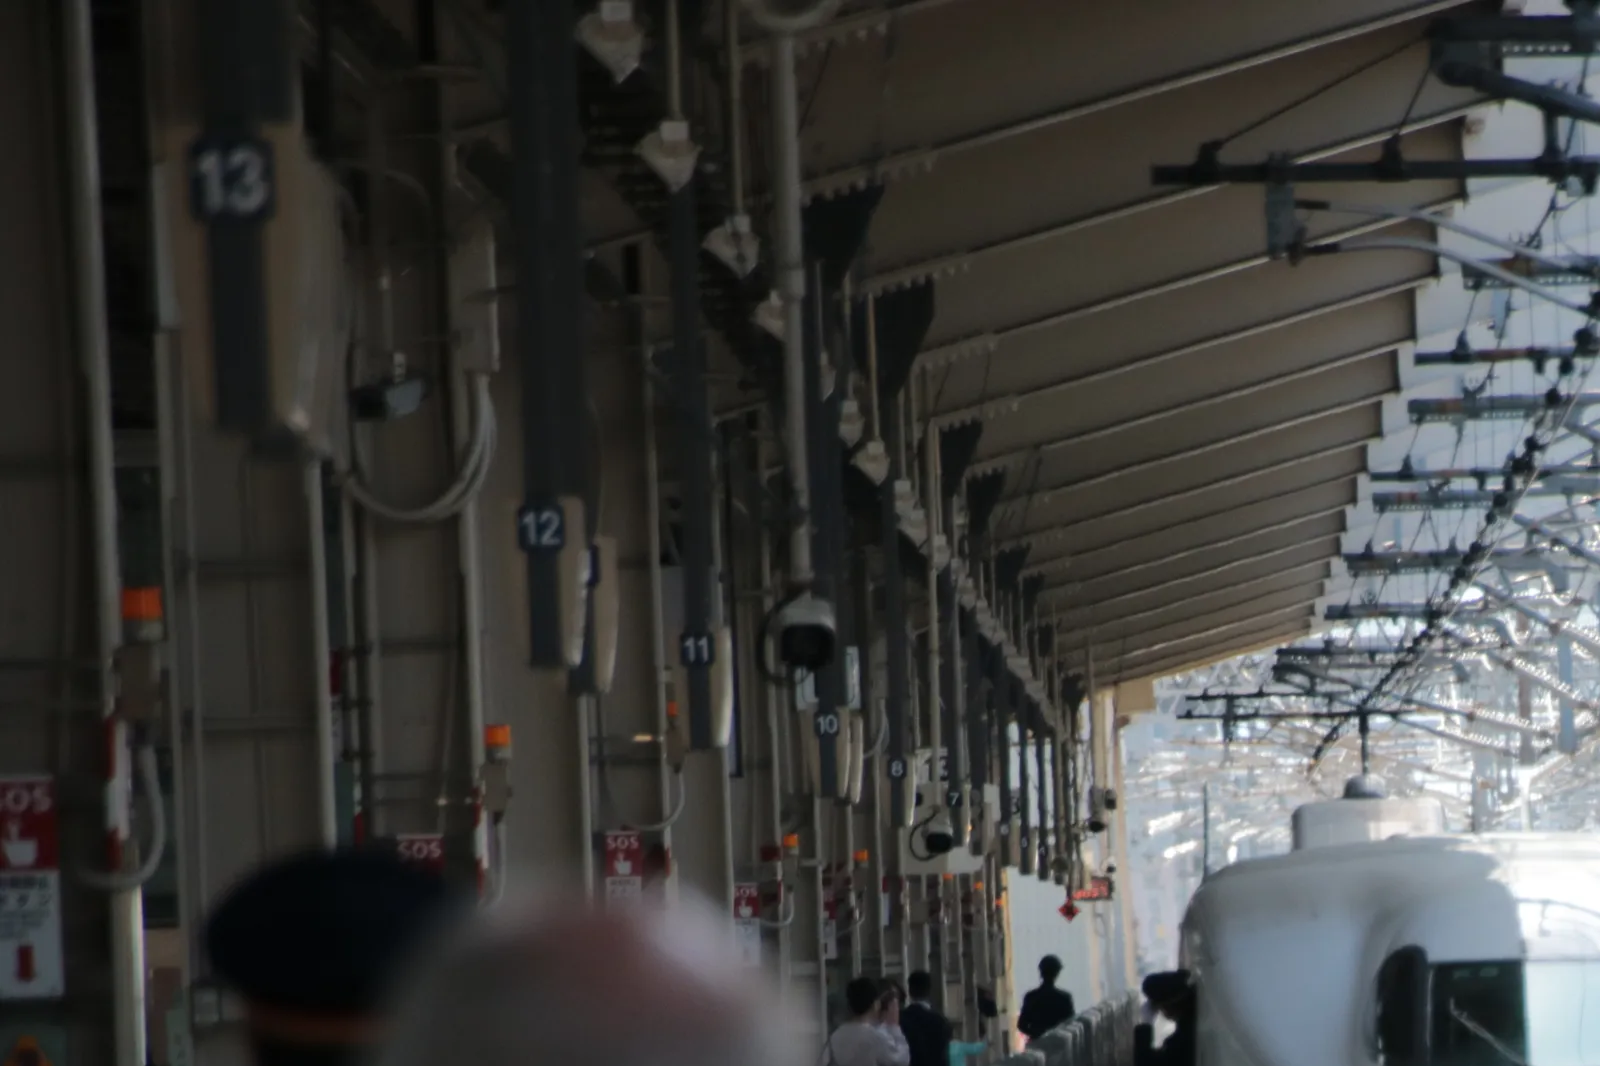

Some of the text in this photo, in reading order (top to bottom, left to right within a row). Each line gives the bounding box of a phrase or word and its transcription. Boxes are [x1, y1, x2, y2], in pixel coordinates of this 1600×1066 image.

[199, 146, 268, 214] 13
[522, 510, 561, 545] 12
[683, 636, 709, 662] 11
[817, 714, 838, 734] 10
[0, 784, 52, 814] OS
[949, 792, 960, 806] 7
[397, 841, 441, 859] SOS
[606, 835, 639, 850] SOS
